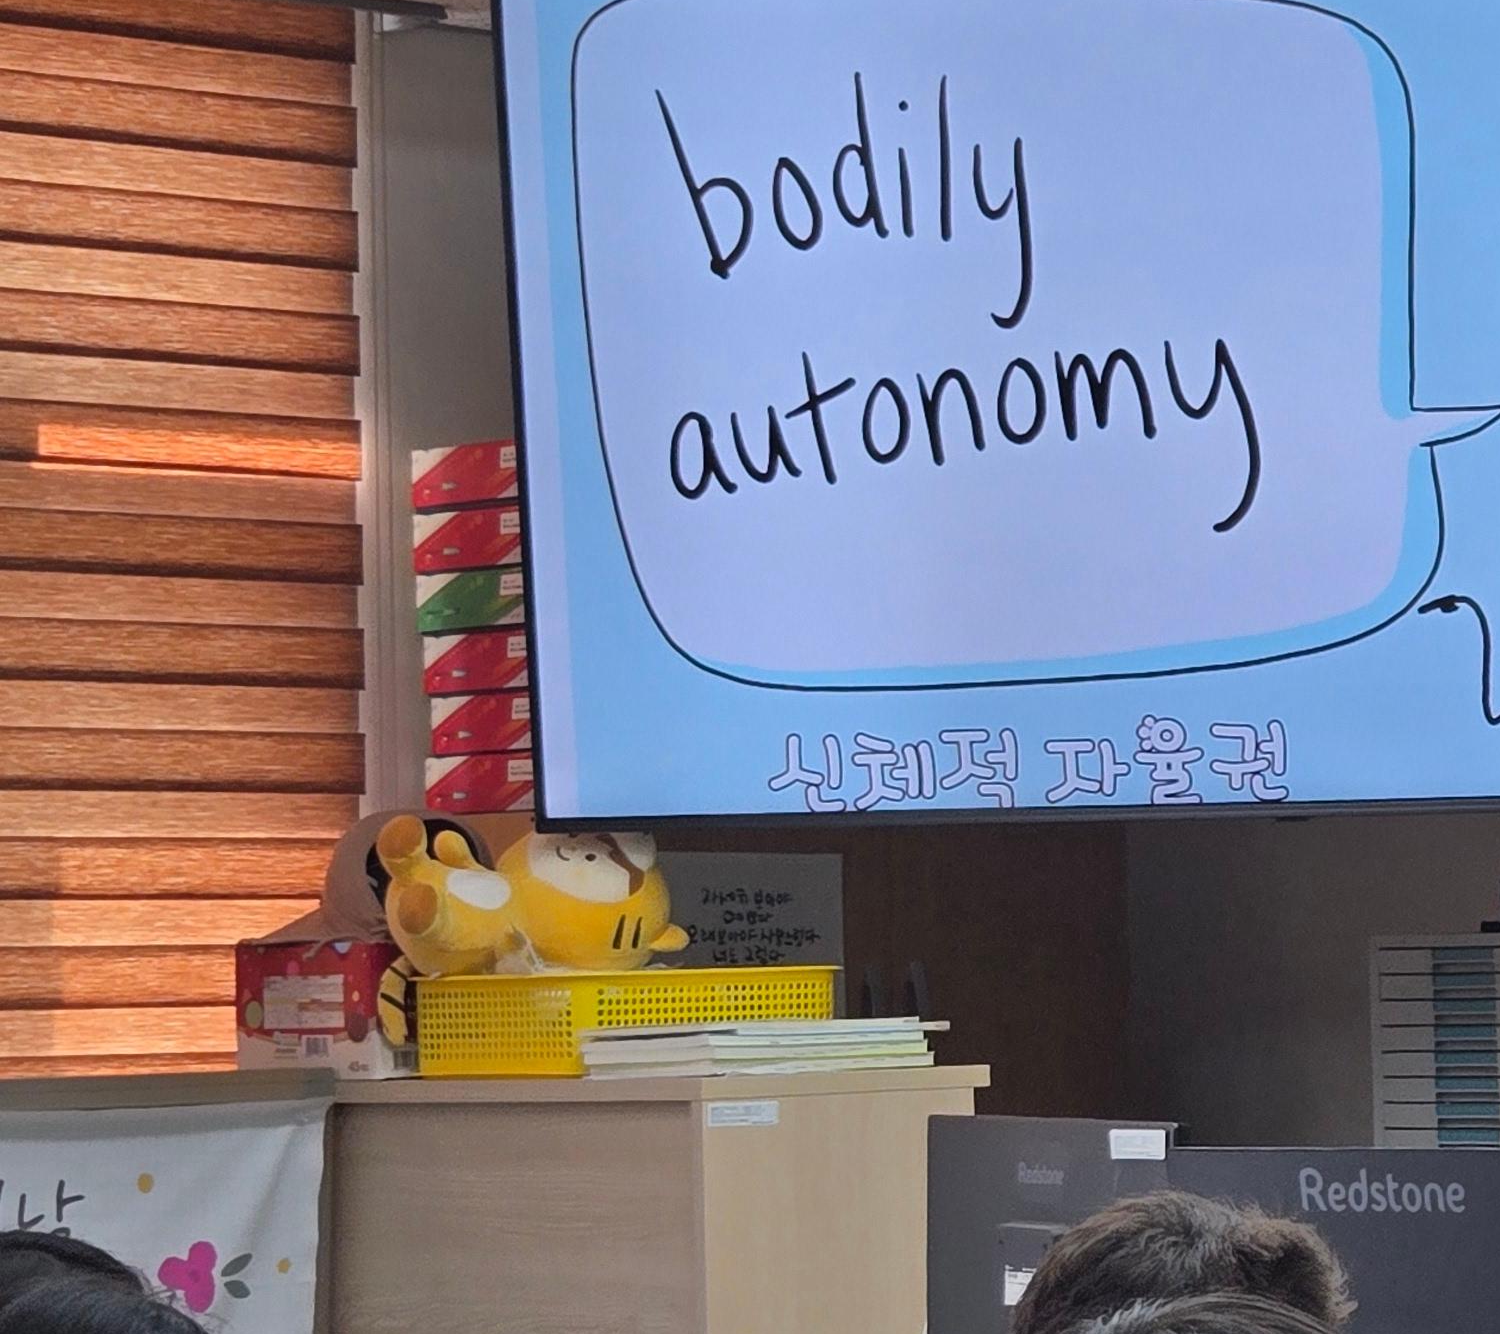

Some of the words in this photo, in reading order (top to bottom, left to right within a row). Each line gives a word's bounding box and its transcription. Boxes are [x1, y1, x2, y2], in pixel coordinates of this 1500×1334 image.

[655, 72, 1034, 328] bodily
[670, 338, 1260, 534] autonomy
[769, 726, 1019, 814] 신체적
[1045, 713, 1289, 806] 자율권
[1298, 1167, 1466, 1215] Redstone
